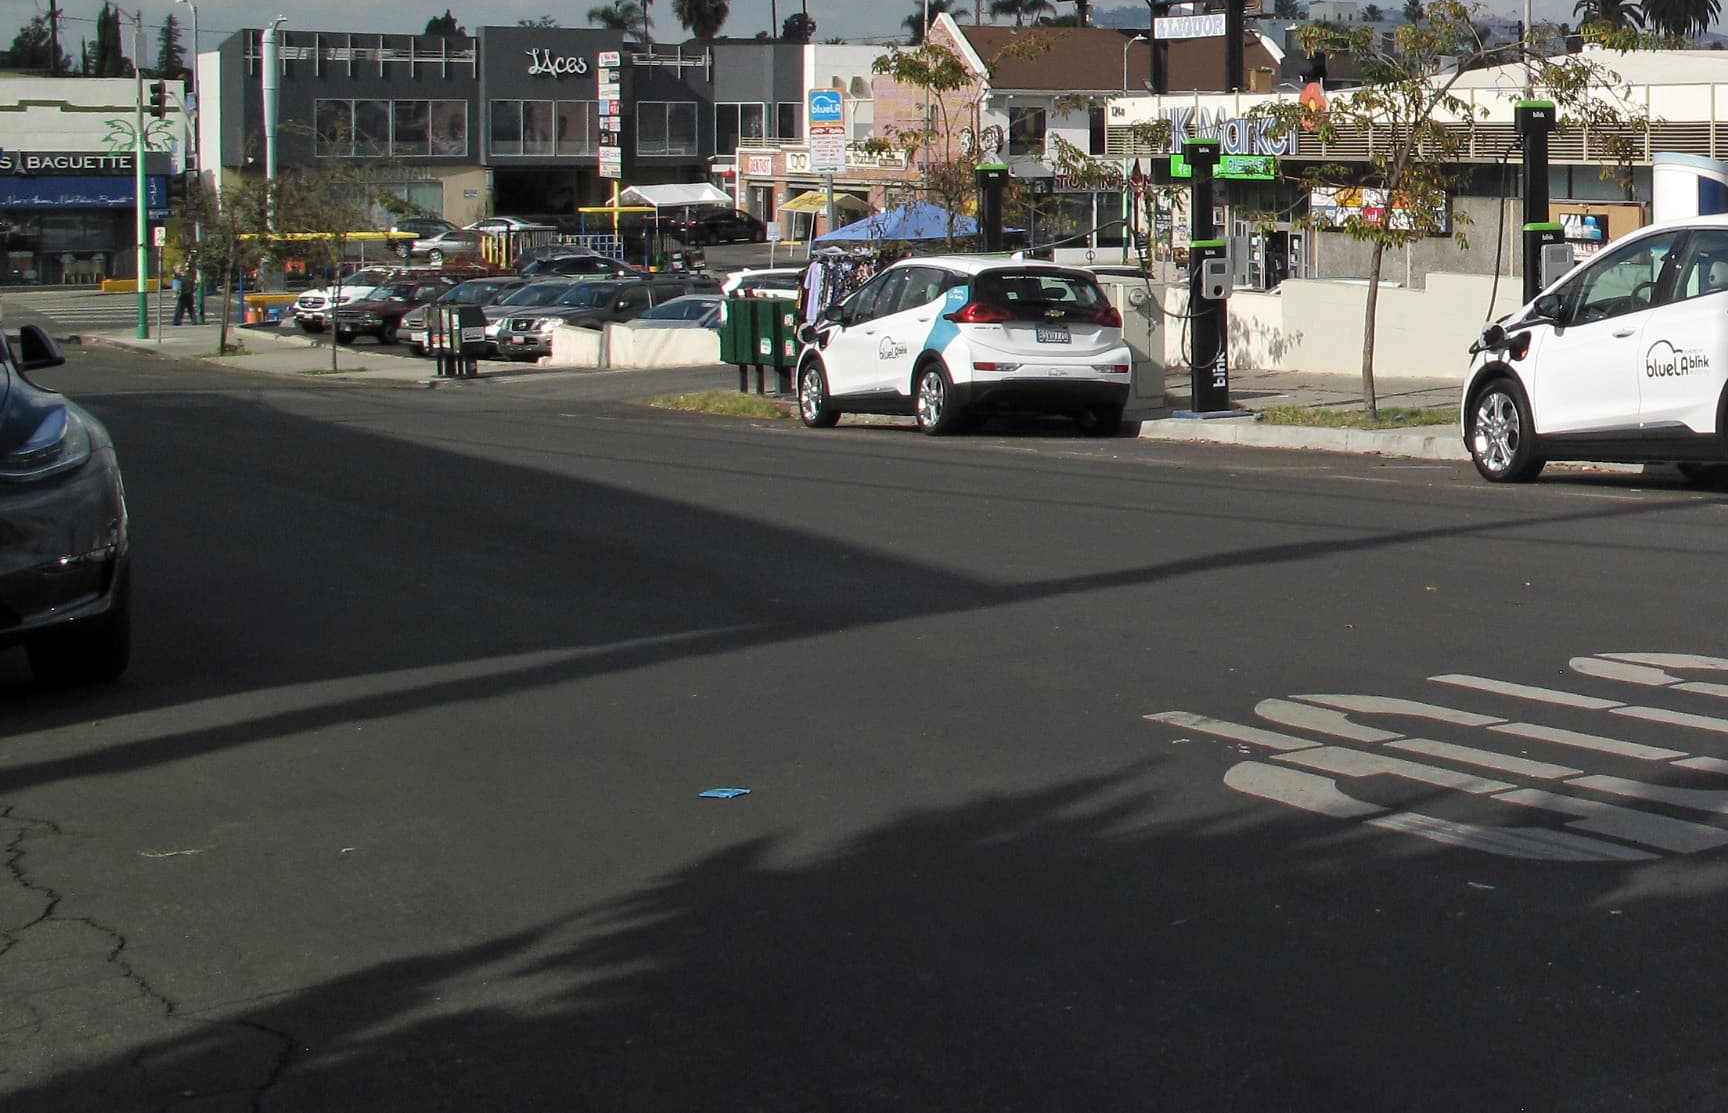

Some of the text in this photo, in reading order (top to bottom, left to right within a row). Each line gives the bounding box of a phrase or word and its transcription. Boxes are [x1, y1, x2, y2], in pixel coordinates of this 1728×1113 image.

[1168, 15, 1224, 36] LIQUOR
[811, 104, 841, 114] blueLA
[27, 156, 132, 169] BAGUETTE
[1213, 351, 1226, 388] blink
[1646, 354, 1710, 378] blueLA blink
